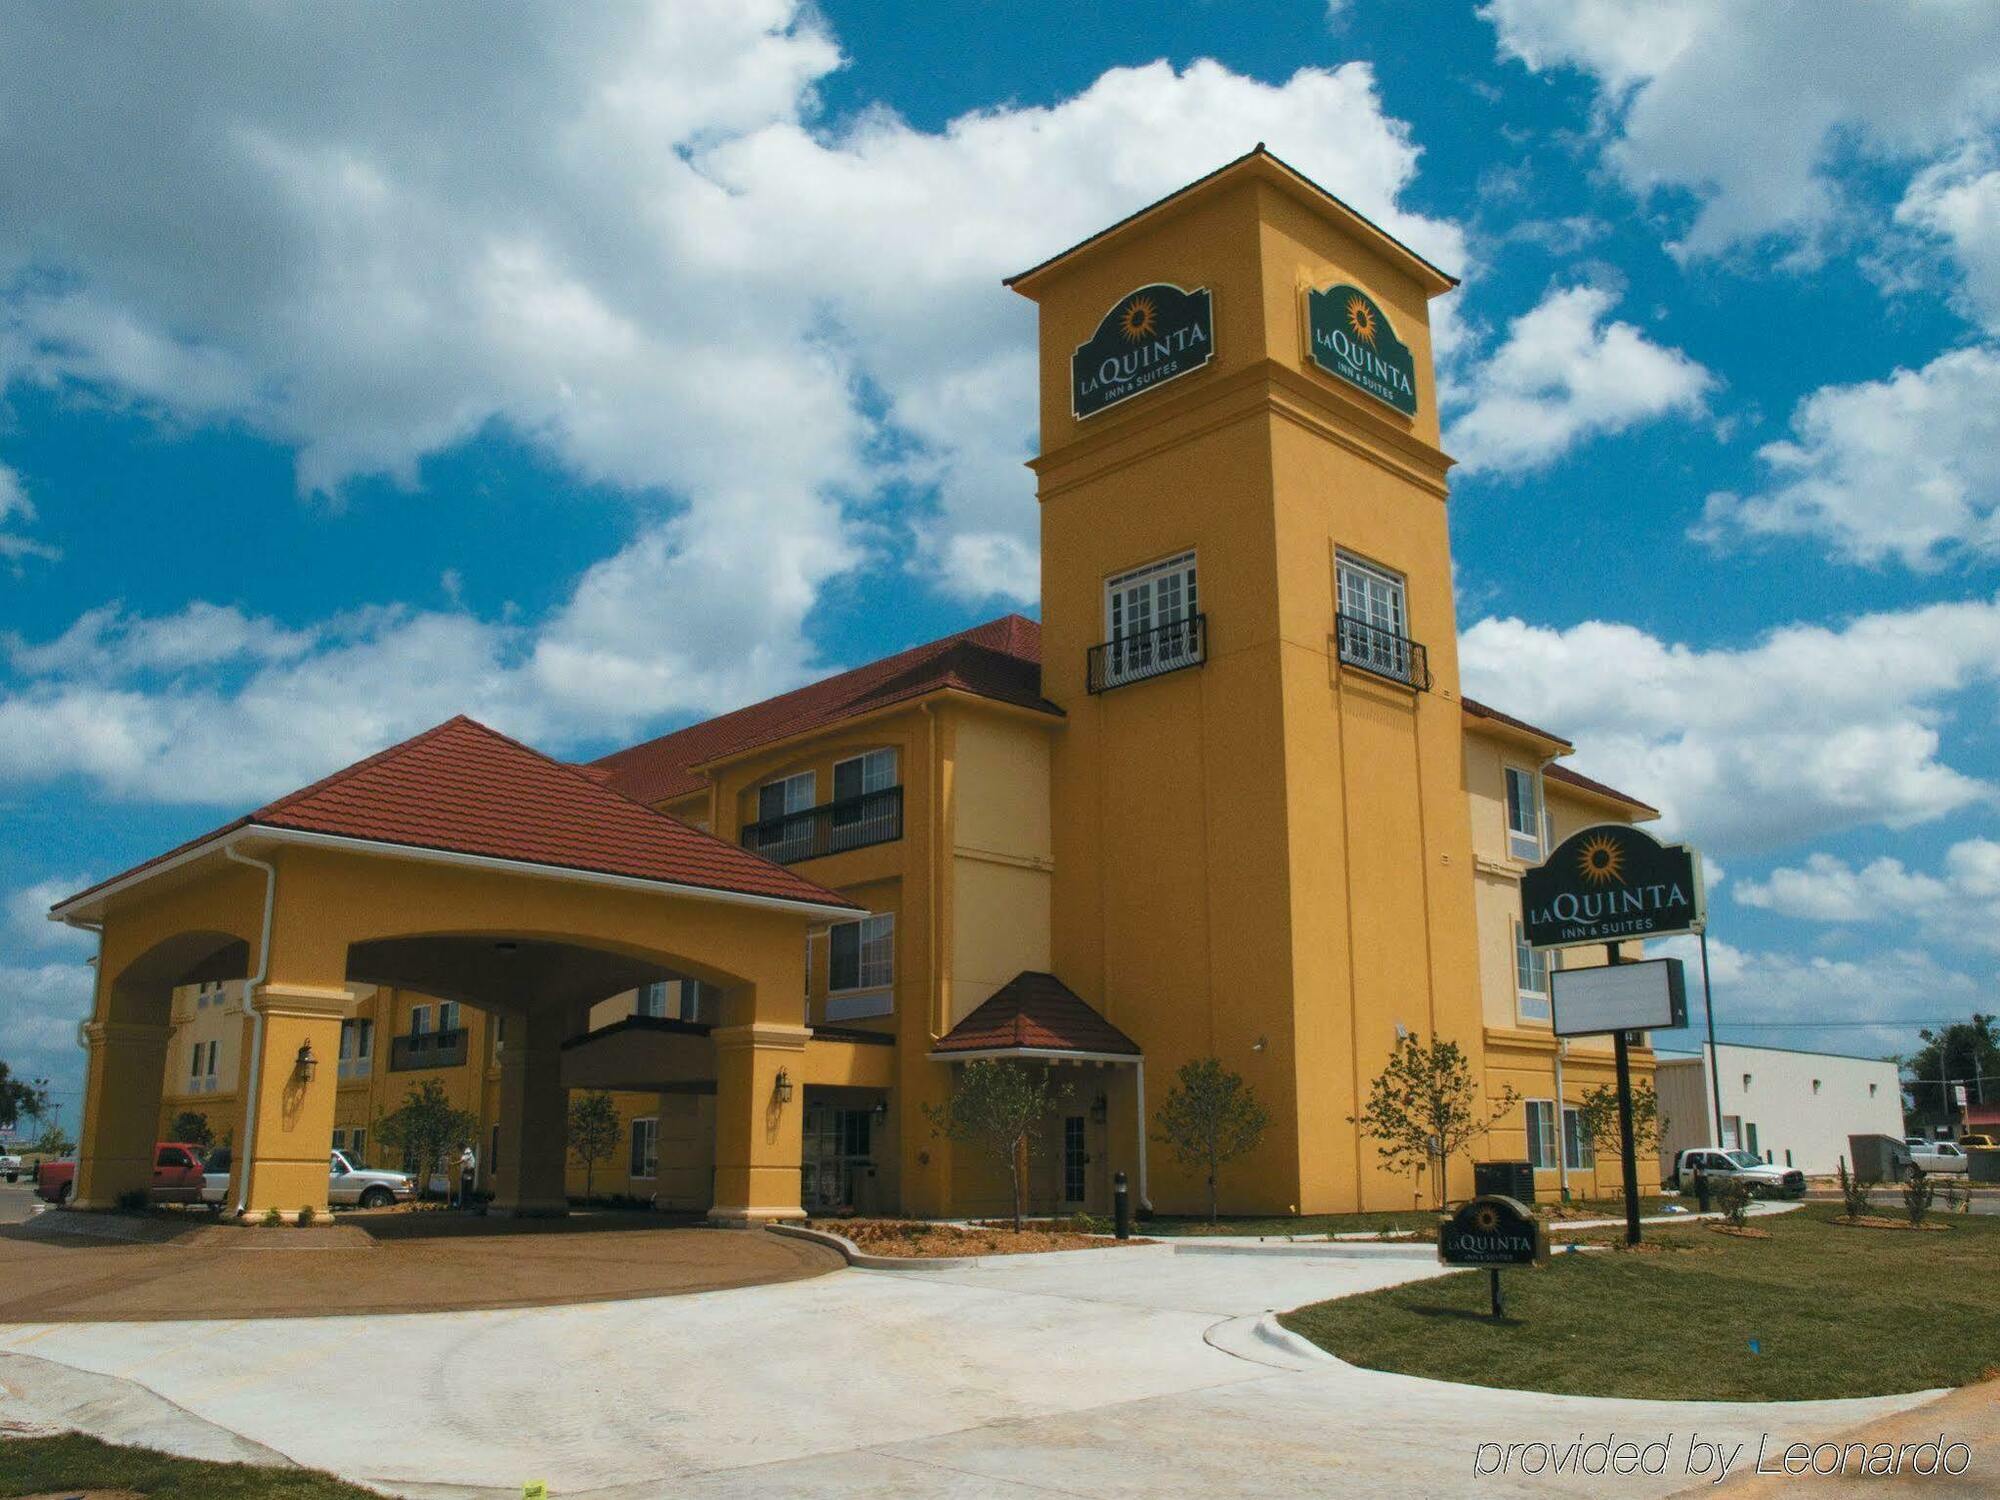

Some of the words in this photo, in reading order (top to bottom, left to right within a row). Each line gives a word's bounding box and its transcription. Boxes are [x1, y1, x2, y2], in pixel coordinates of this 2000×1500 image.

[1099, 323, 1206, 385] QUINTA
[1332, 330, 1412, 395] QUINTA
[1105, 384, 1125, 401] INN
[1136, 361, 1178, 386] SUITES
[1338, 362, 1354, 377] INN
[1363, 376, 1393, 400] SUITES
[1553, 882, 1687, 924] QUINTA
[1562, 927, 1586, 938] INN
[1590, 928, 1598, 936] &
[1602, 918, 1653, 934] SUITES
[1460, 1234, 1531, 1254] QUINTA
